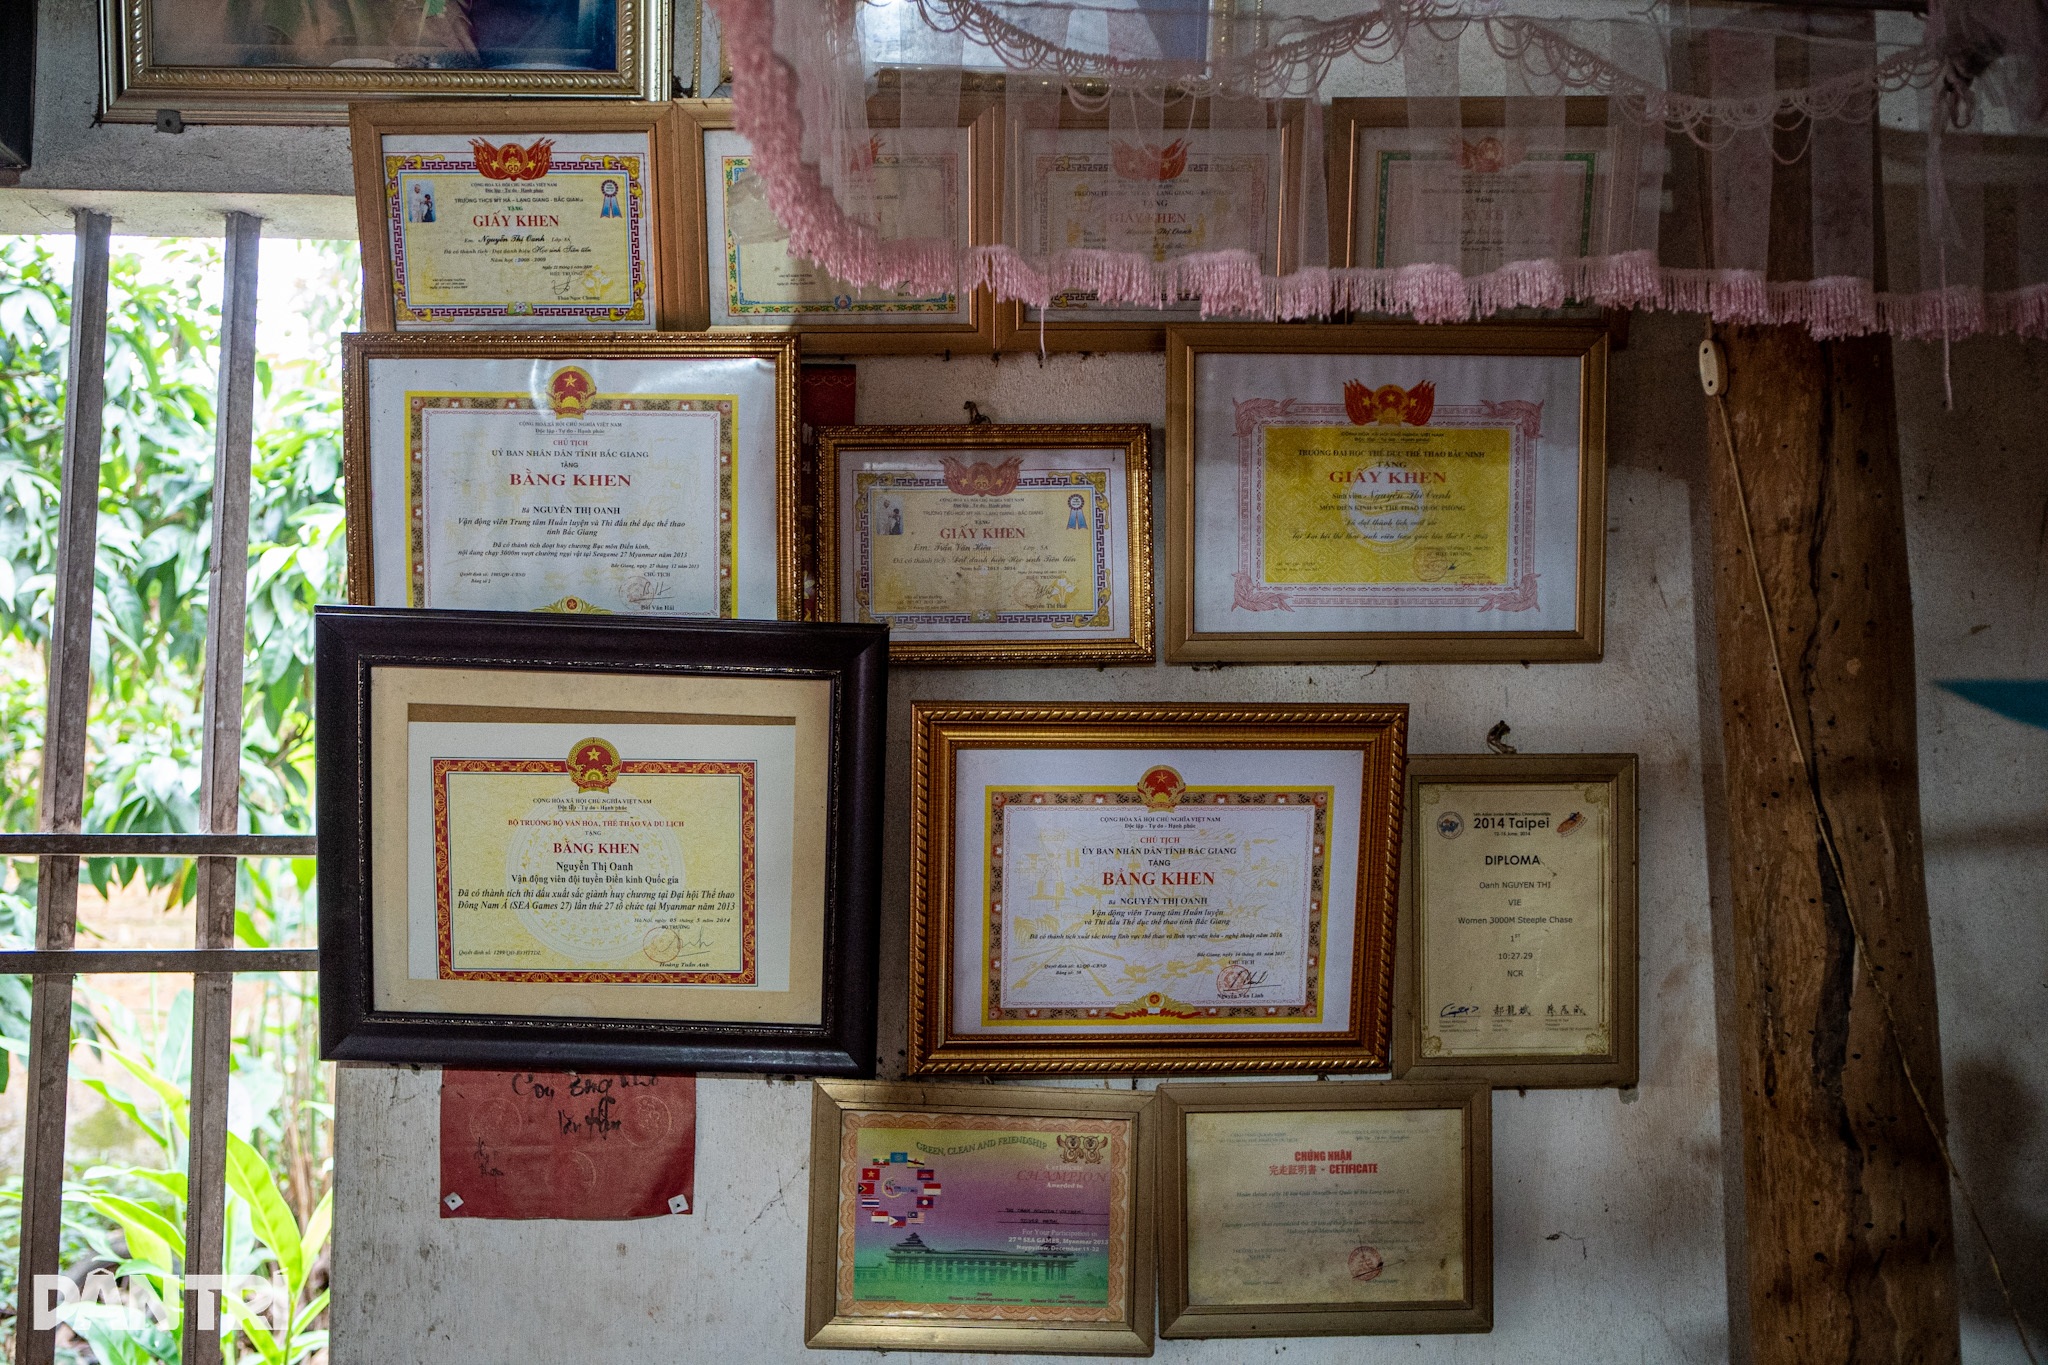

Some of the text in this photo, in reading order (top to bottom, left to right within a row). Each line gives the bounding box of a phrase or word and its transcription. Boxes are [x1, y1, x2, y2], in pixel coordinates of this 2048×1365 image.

[473, 210, 559, 226] GIẤY KHEN
[510, 468, 631, 486] BẰNG KHEN
[1330, 466, 1446, 484] GIẤY KHEN
[940, 524, 1025, 538] GIẤY KHEN
[1474, 817, 1549, 830] 2014 Taipei
[553, 838, 639, 853] BẰNG KHEN
[556, 860, 633, 872] Nguyễn Thị Oanh
[1485, 855, 1540, 865] DIPLOMA
[1103, 868, 1215, 886] BẰNG KHEN
[1518, 917, 1546, 925] Steeple
[947, 1144, 976, 1155] CLEAN
[978, 1140, 996, 1150] AND
[998, 1136, 1047, 1150] FRIENDSHIP
[1328, 1149, 1352, 1163] NHẬN
[1330, 1164, 1378, 1174] CETIFICATE
